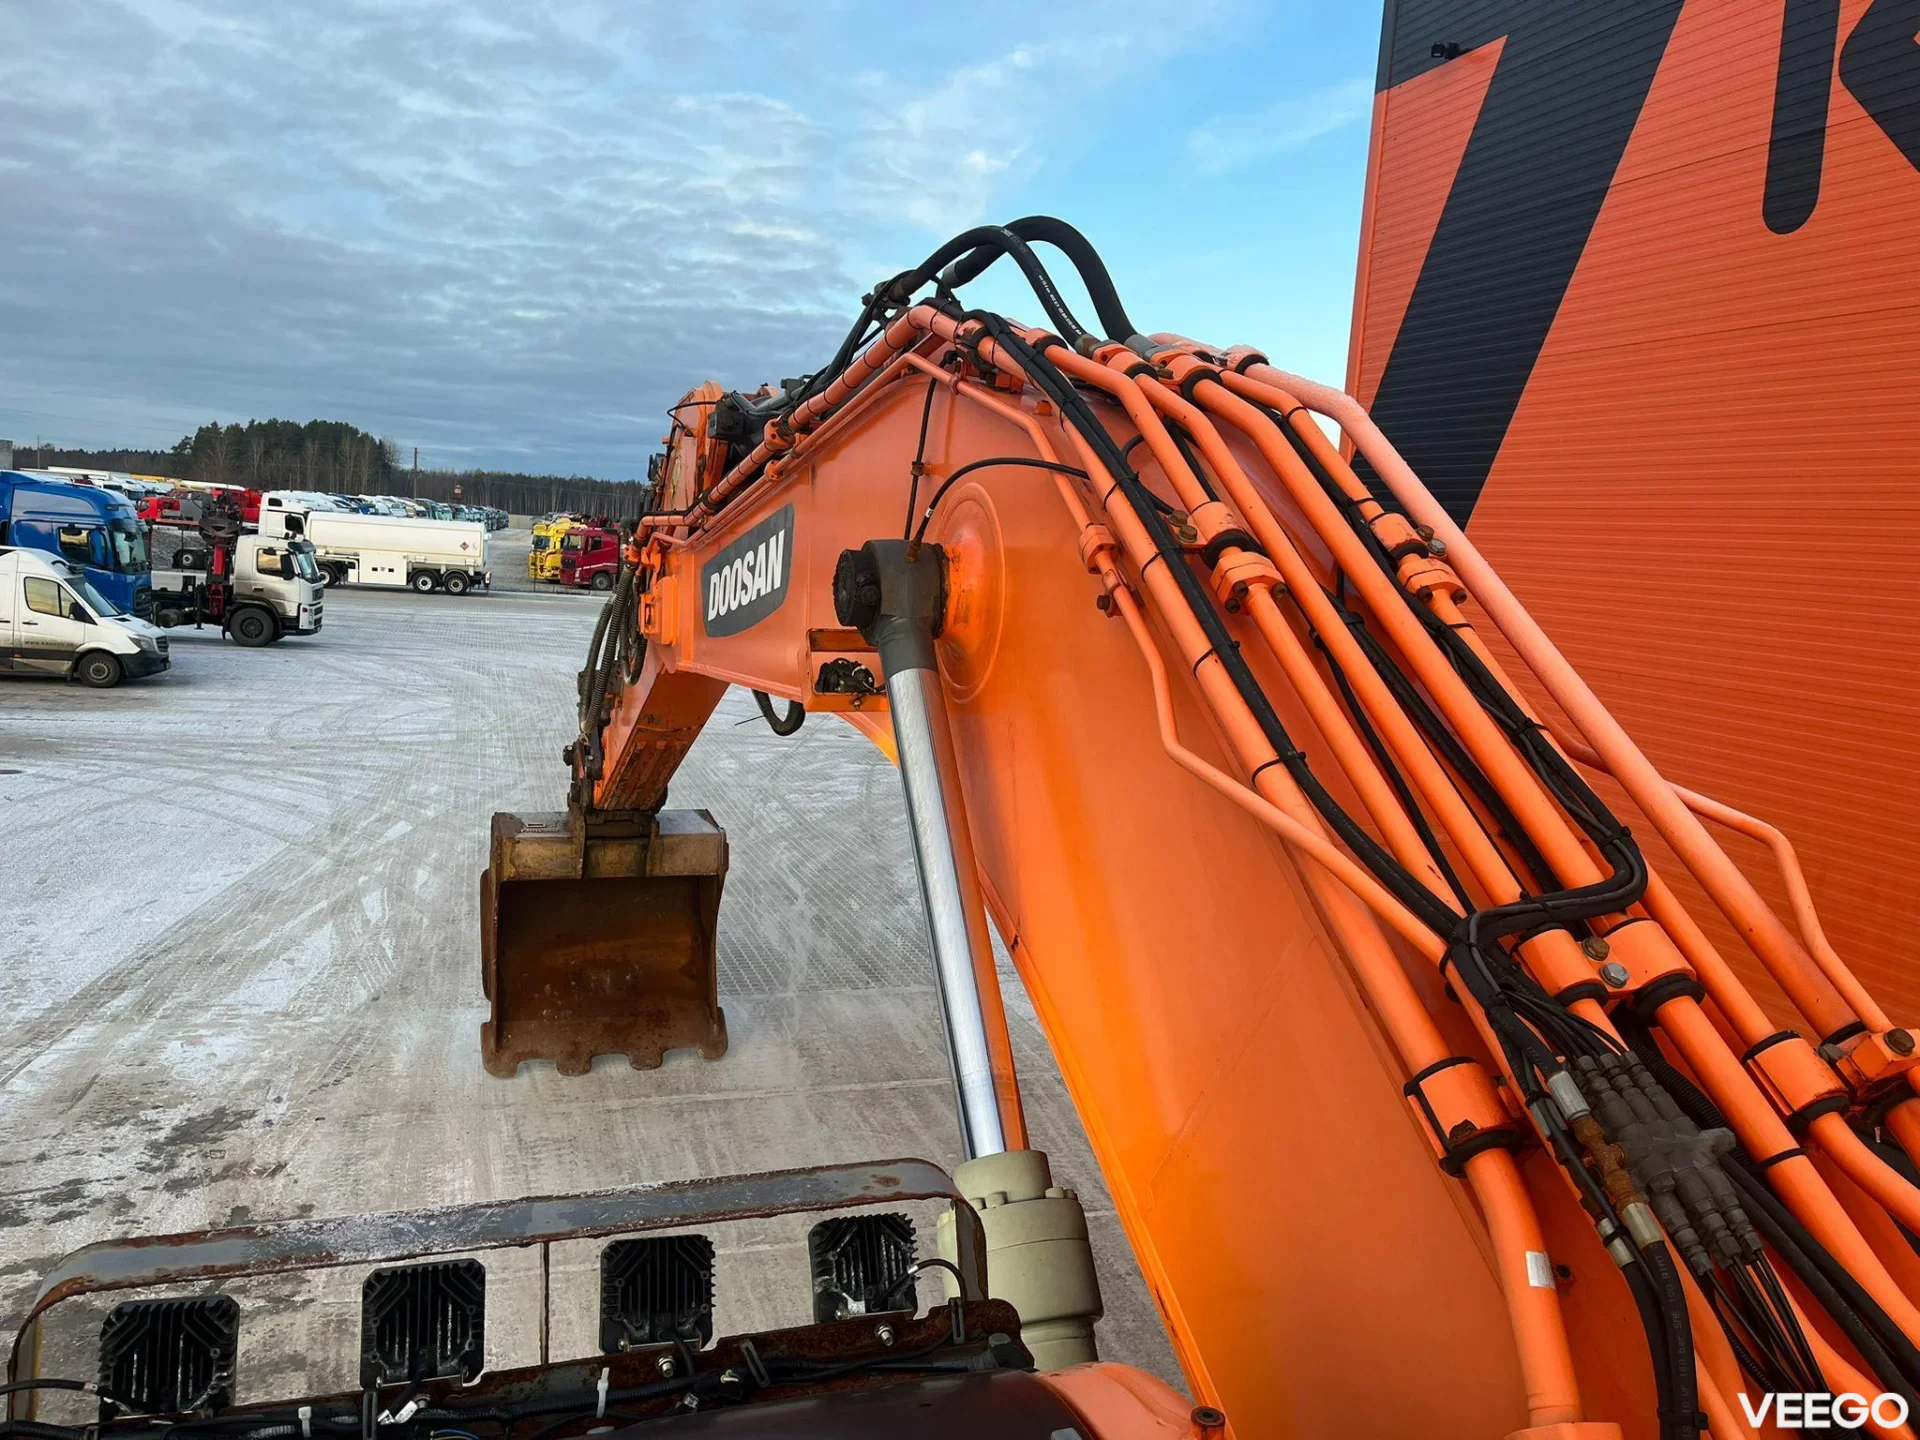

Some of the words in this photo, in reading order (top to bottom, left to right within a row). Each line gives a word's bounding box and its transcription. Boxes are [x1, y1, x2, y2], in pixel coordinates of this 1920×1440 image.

[707, 529, 785, 622] DOOSAN
[1666, 1284, 1676, 1302] 100
[1672, 1309, 1682, 1330] SAE
[1676, 1334, 1686, 1354] bar
